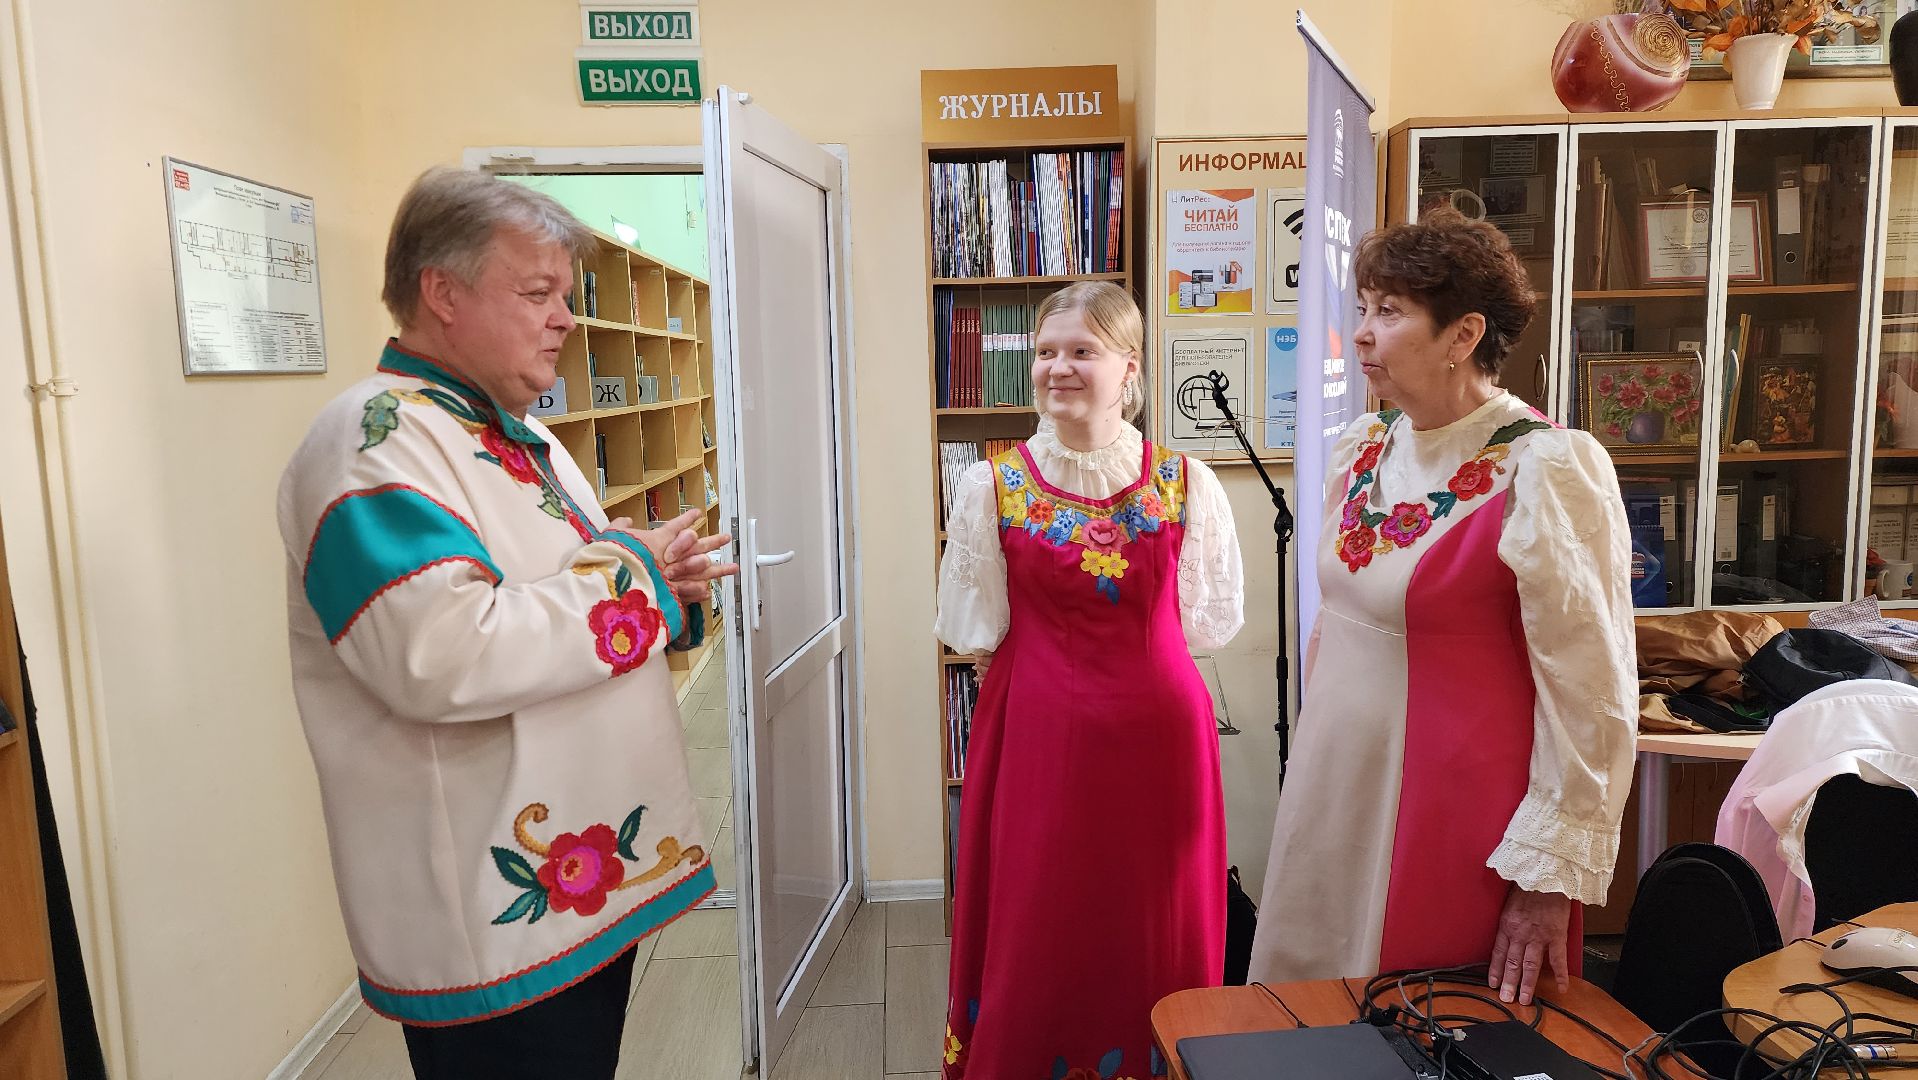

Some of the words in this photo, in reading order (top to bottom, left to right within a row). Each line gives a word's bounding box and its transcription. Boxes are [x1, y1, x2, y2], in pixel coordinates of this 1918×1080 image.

[594, 15, 689, 39] ВЫХОД
[588, 68, 694, 97] ВЫХОД
[938, 91, 1103, 120] ЖУРНАЛЫ
[1184, 204, 1238, 223] ЧИТАЙ
[1184, 222, 1239, 232] БЕСПЛАТНО
[1276, 335, 1297, 343] НЭБ
[595, 384, 622, 403] Ж
